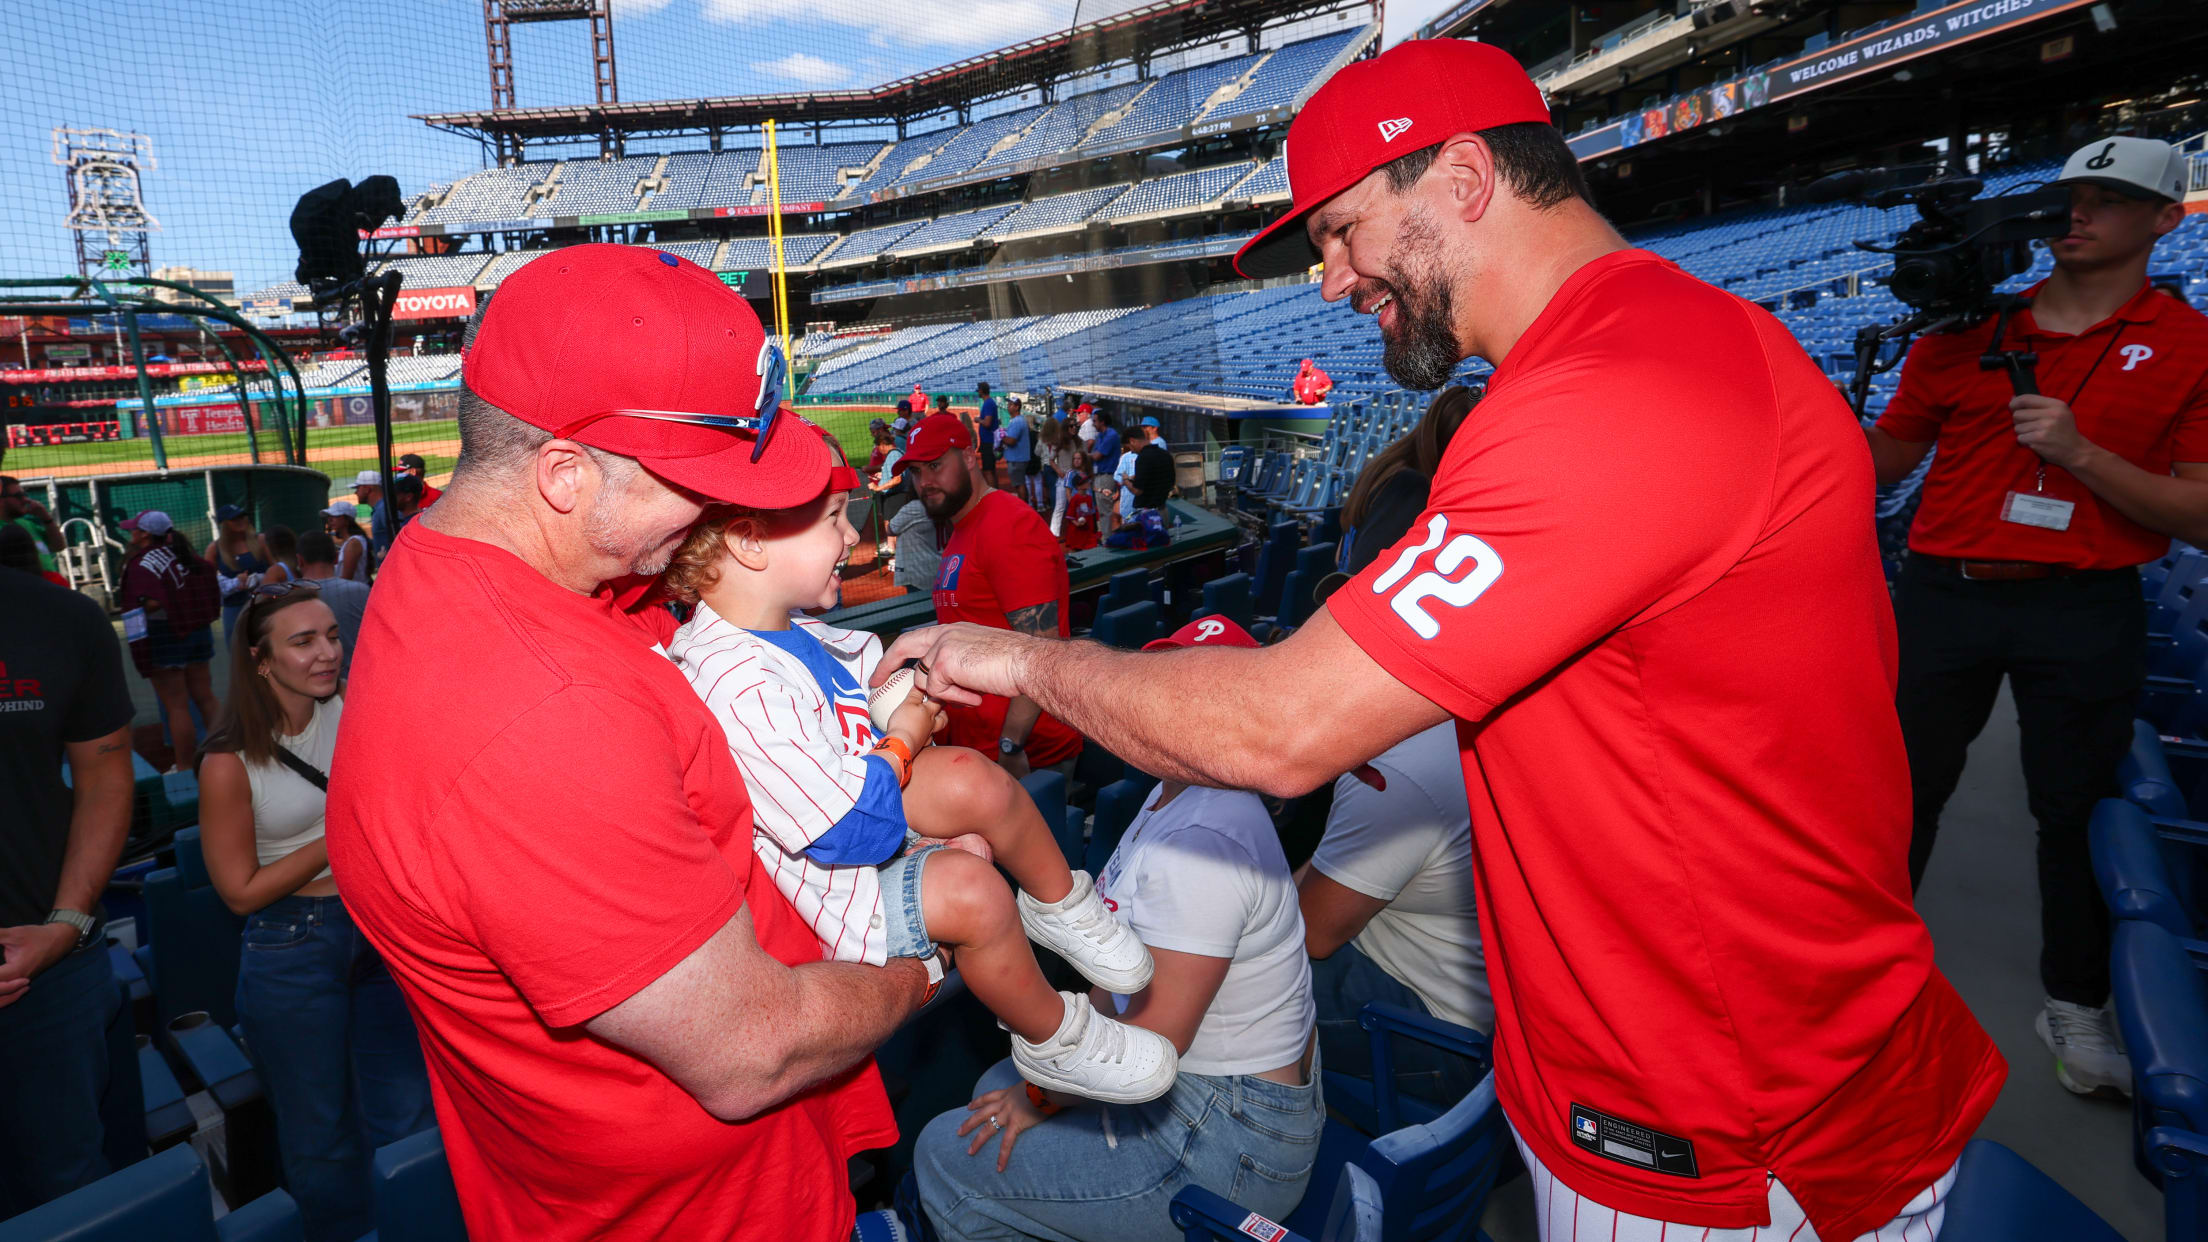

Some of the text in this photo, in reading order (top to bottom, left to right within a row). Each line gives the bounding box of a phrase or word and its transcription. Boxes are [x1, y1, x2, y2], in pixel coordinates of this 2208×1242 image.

[1790, 0, 2033, 83] WELCOME WIZARDS, WITCHES
[396, 294, 470, 312] TOYOTA
[2120, 344, 2153, 371] P
[910, 427, 922, 445] P
[942, 555, 960, 588] P
[1372, 512, 1504, 640] 12
[1194, 620, 1225, 641] P
[1603, 1119, 1651, 1139] ENGINEERED
